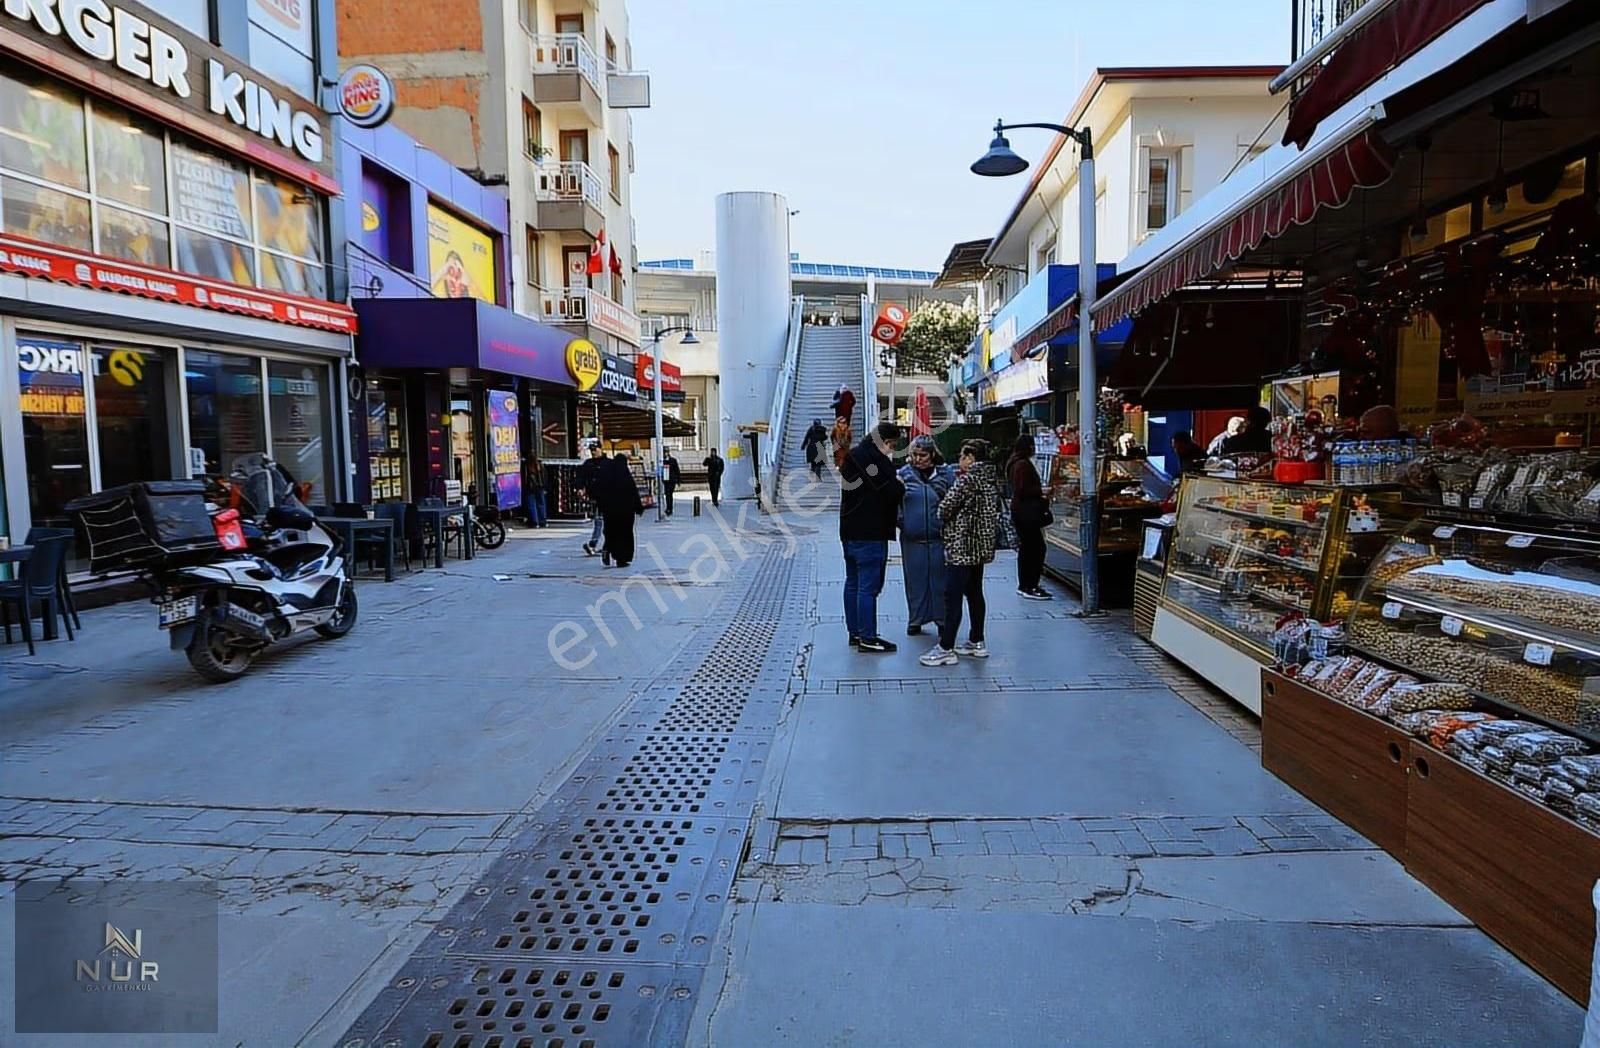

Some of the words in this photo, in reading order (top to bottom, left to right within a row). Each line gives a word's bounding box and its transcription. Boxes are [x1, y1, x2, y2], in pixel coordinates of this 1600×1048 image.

[208, 57, 323, 163] KING
[344, 88, 380, 108] KING
[574, 348, 599, 373] gratis
